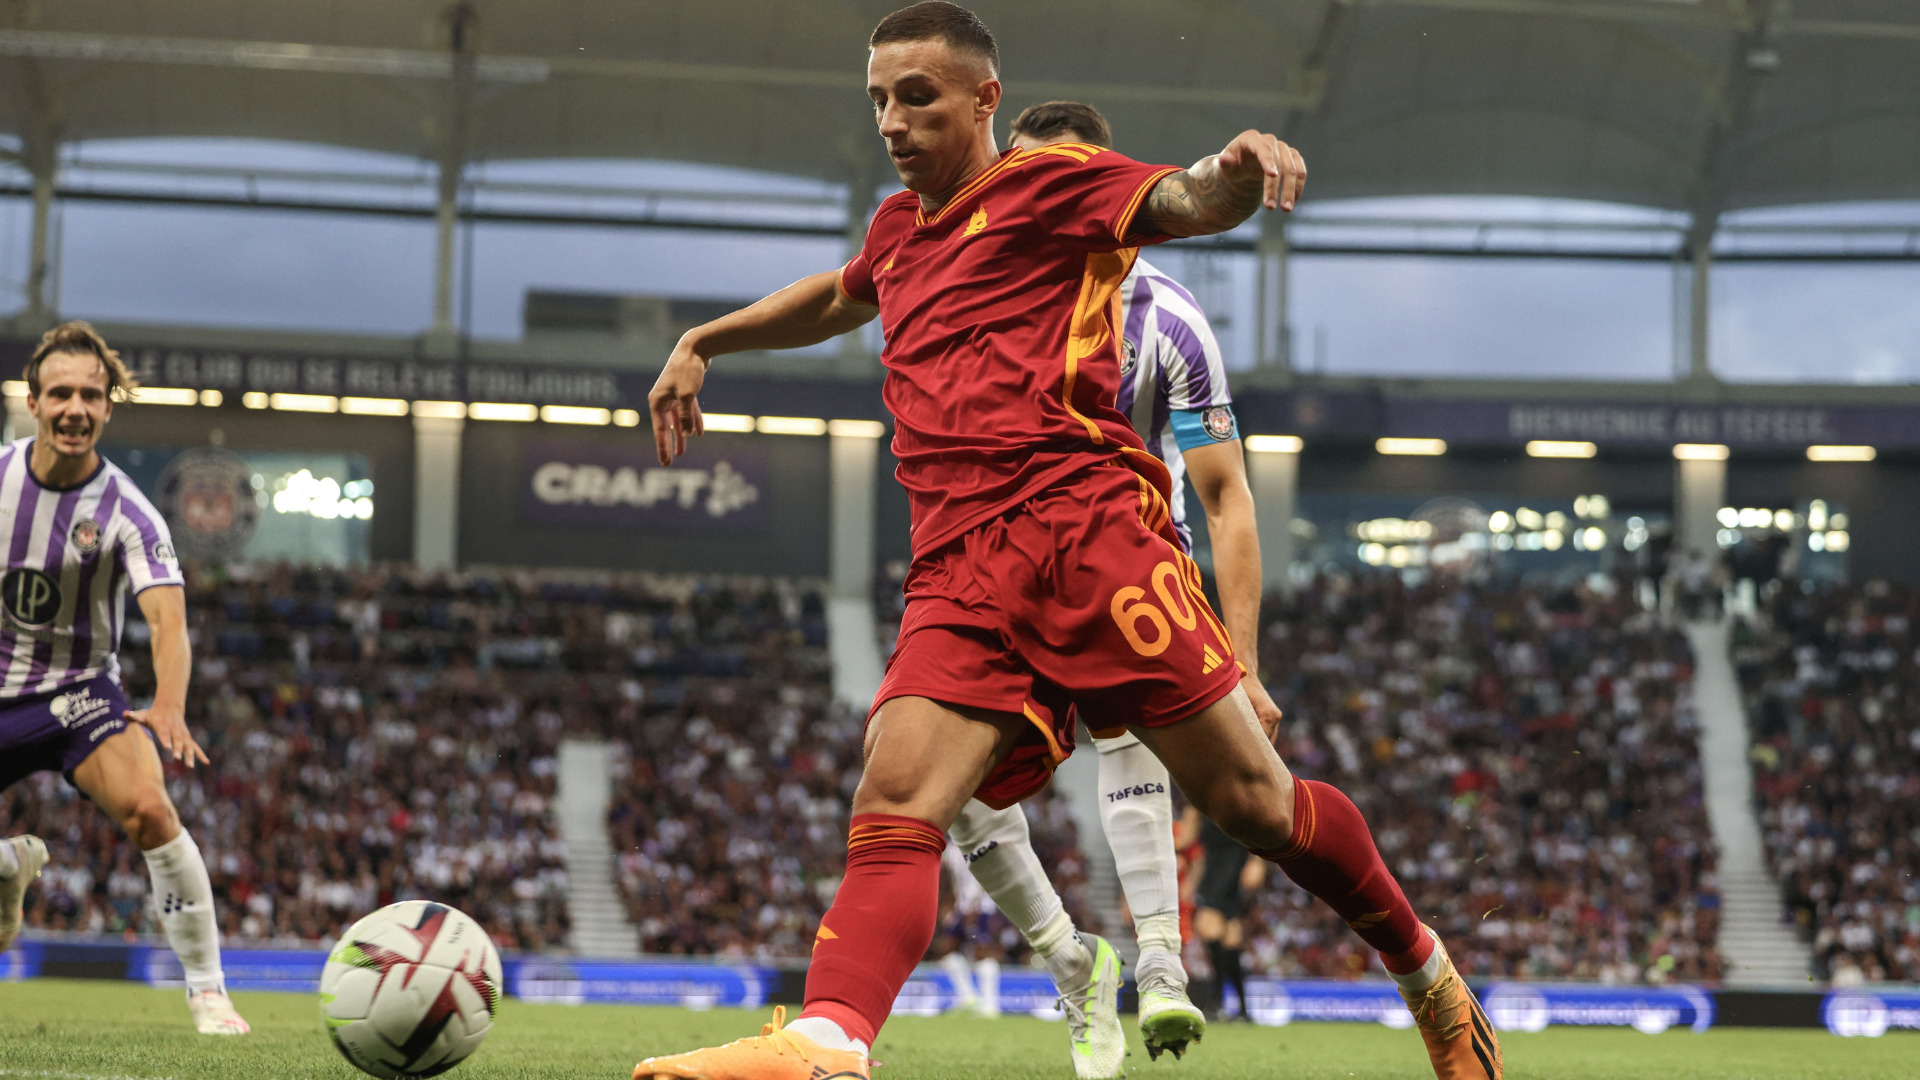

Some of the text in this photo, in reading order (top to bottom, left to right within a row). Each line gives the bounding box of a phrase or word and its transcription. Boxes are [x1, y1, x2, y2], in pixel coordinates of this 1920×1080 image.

[1508, 405, 1667, 439] BIENVENUE
[1674, 407, 1716, 440] AU
[532, 461, 709, 510] CRAFT
[16, 571, 51, 620] LP
[1111, 561, 1197, 657] 60
[1107, 782, 1165, 803] TéFéCé
